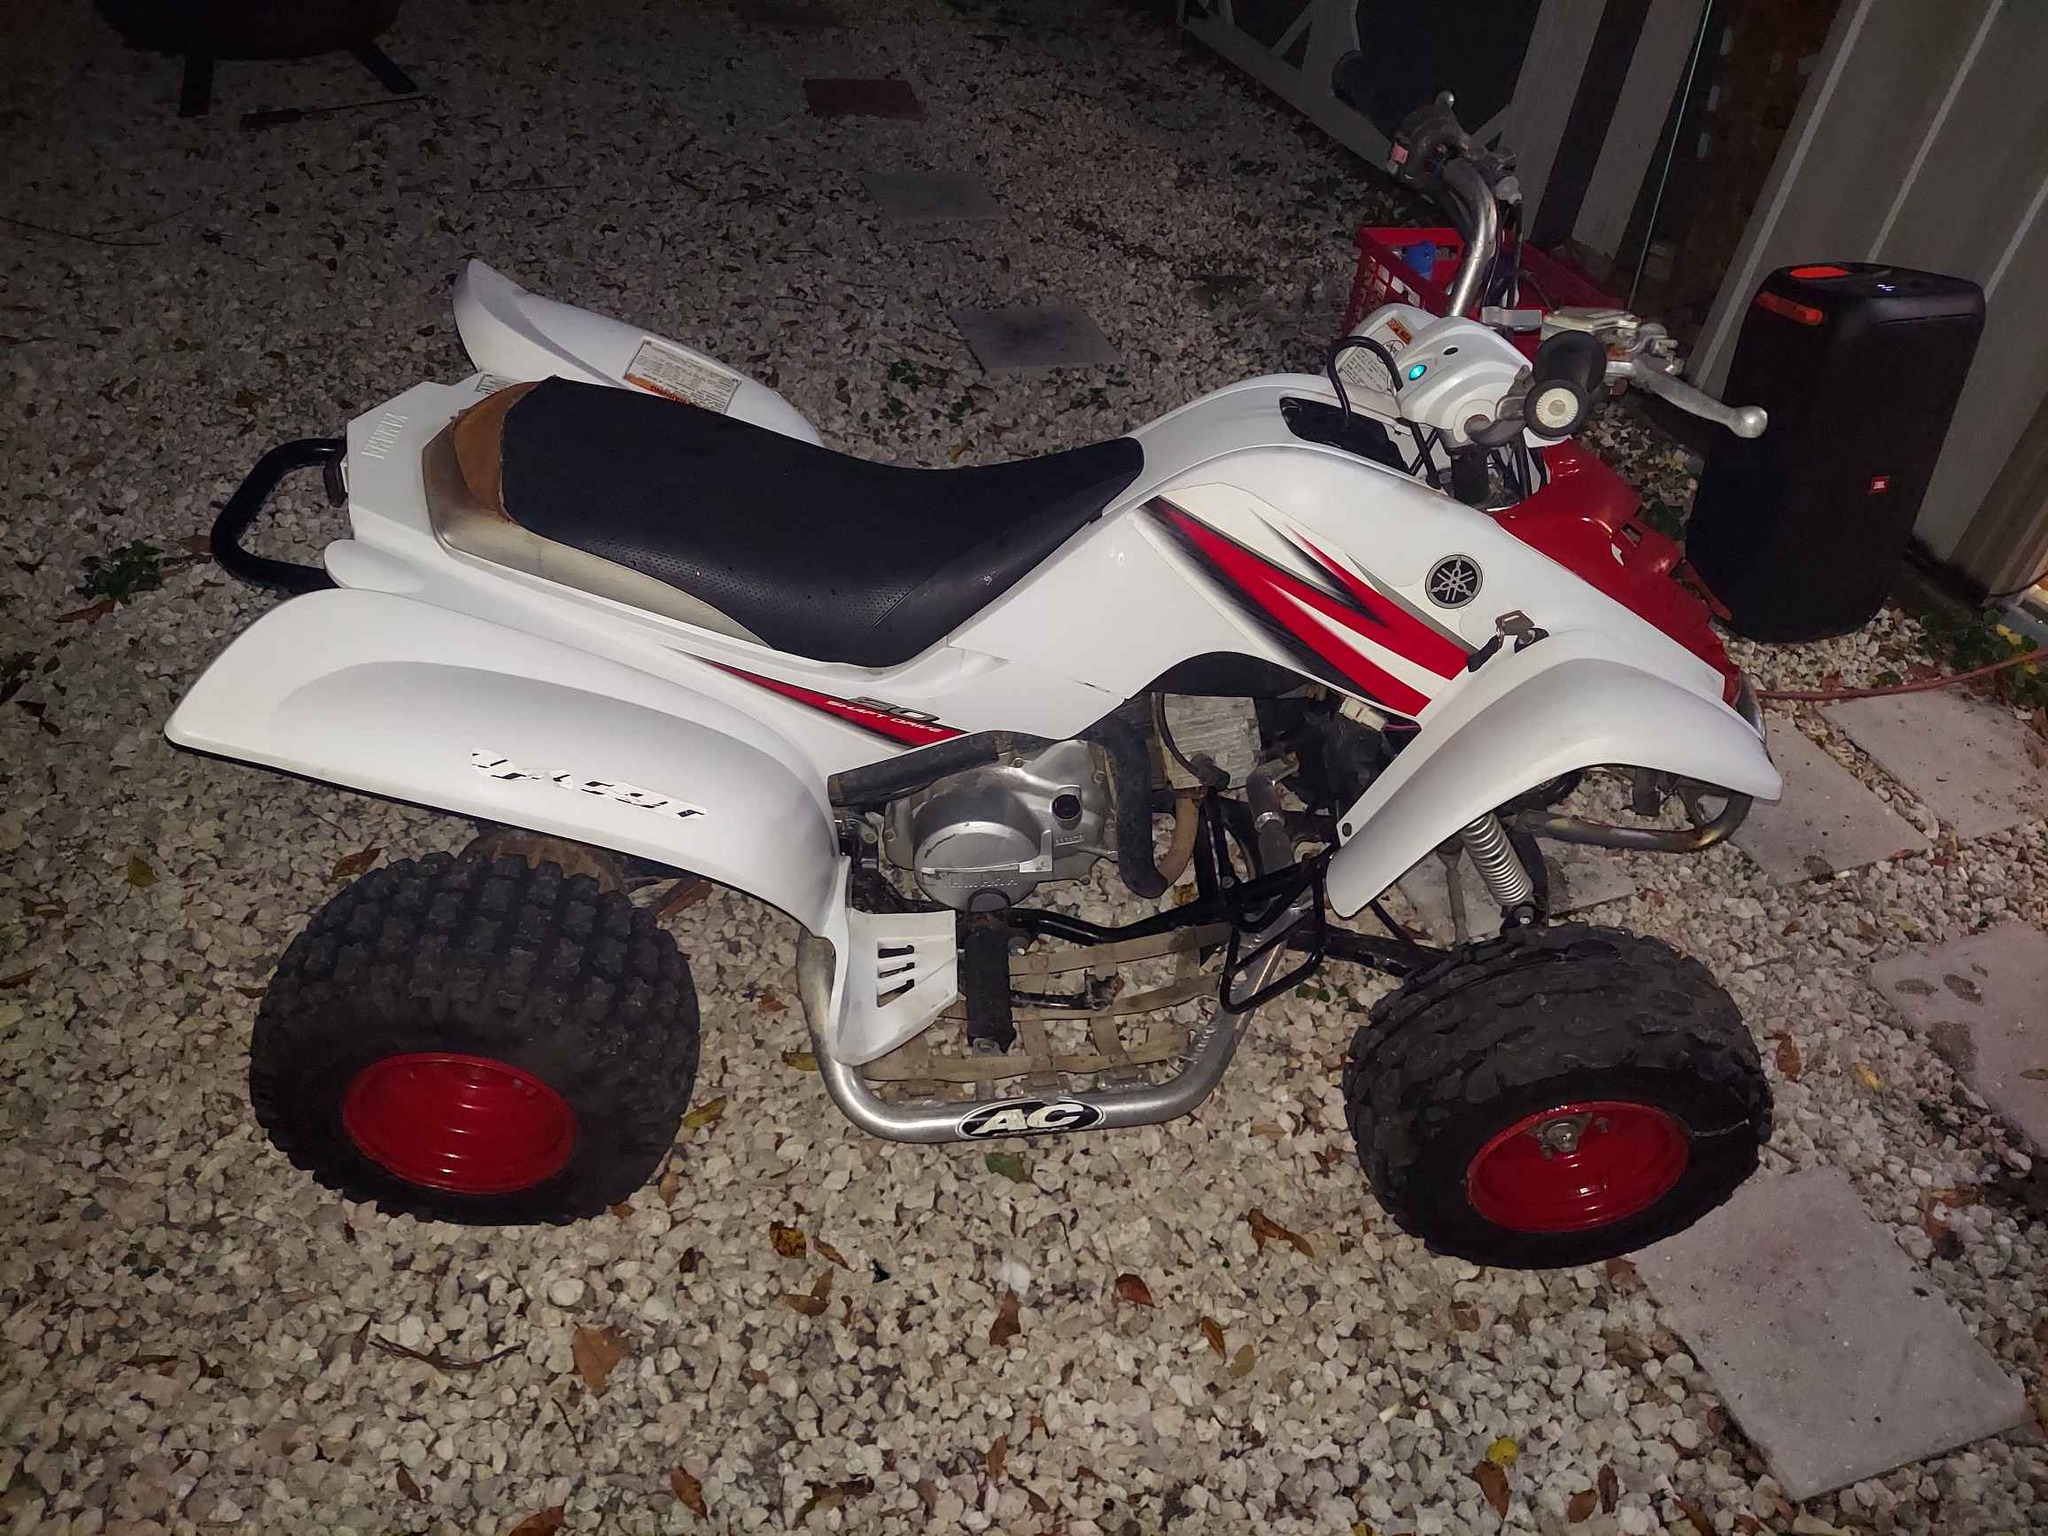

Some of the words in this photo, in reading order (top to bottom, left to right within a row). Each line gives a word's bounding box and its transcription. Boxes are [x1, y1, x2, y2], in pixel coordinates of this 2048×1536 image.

[825, 700, 889, 719] SHAFT
[889, 717, 944, 733] DRIVE
[970, 1103, 1085, 1135] AC
